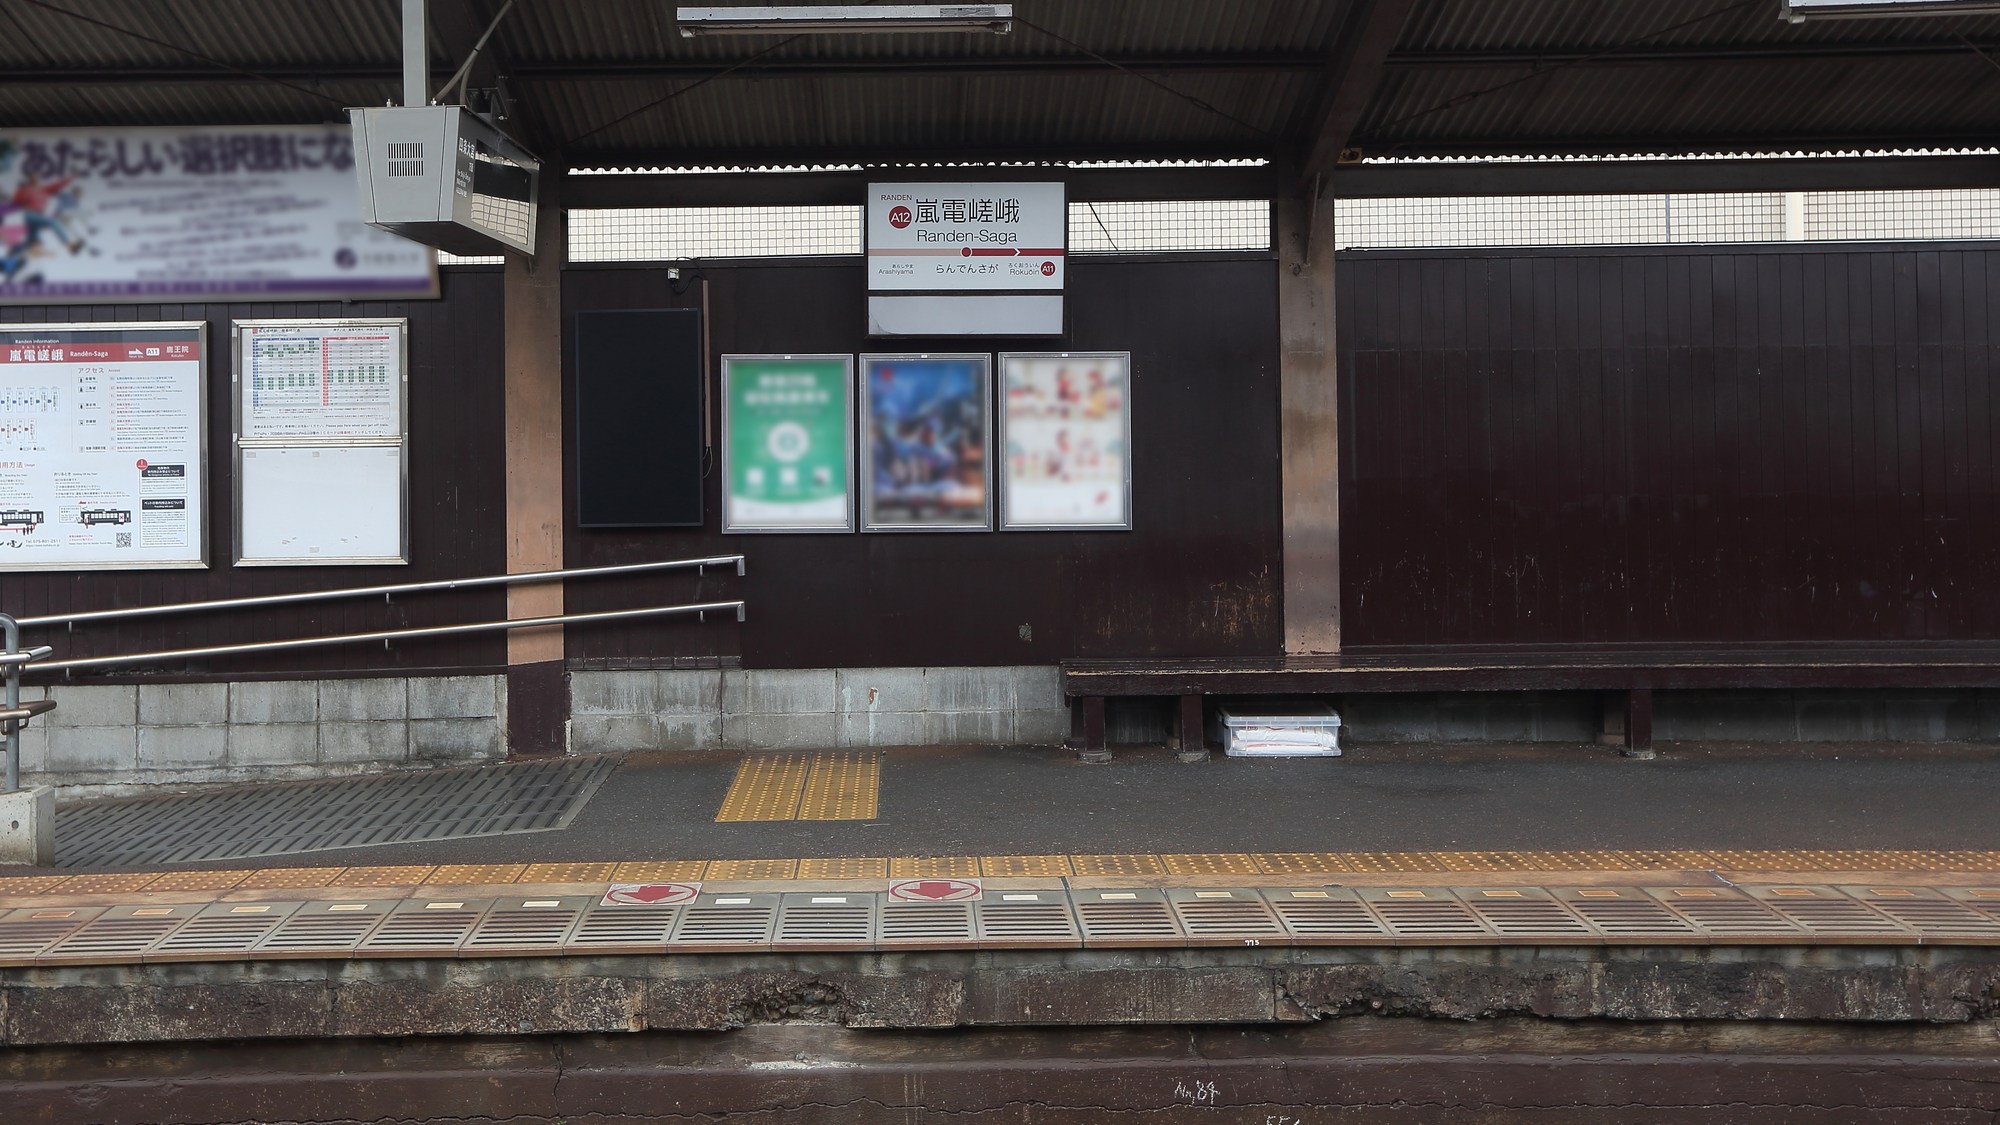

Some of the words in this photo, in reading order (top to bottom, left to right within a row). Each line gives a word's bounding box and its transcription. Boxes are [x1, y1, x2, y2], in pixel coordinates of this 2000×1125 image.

[459, 137, 475, 159] 四条大宮
[891, 212, 911, 223] A12
[915, 198, 1020, 224] 嵐電嵯峨
[917, 229, 1017, 245] Randen-Saga
[936, 264, 999, 274] らんでんさが
[10, 349, 64, 362] 嵐電嵯峨
